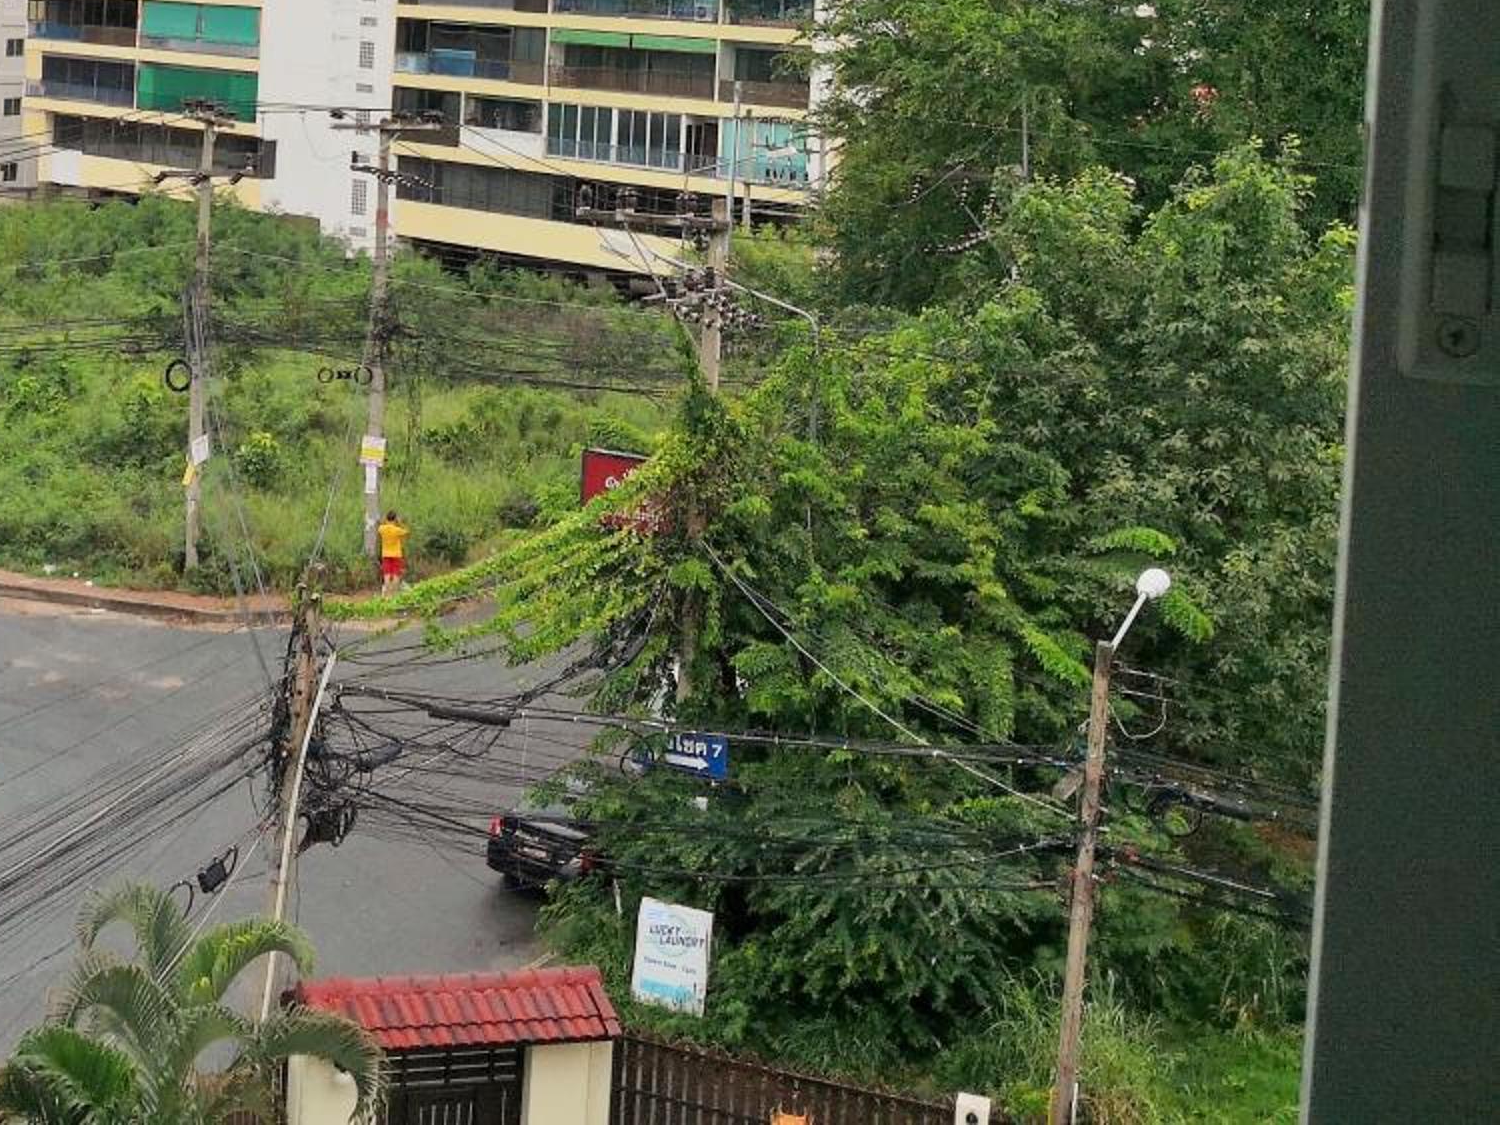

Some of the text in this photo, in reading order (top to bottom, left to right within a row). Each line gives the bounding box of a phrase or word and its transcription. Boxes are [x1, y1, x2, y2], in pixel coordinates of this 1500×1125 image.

[712, 744, 722, 758] 7
[649, 924, 681, 936] LUCKY
[659, 936, 705, 949] LAUNDRY
